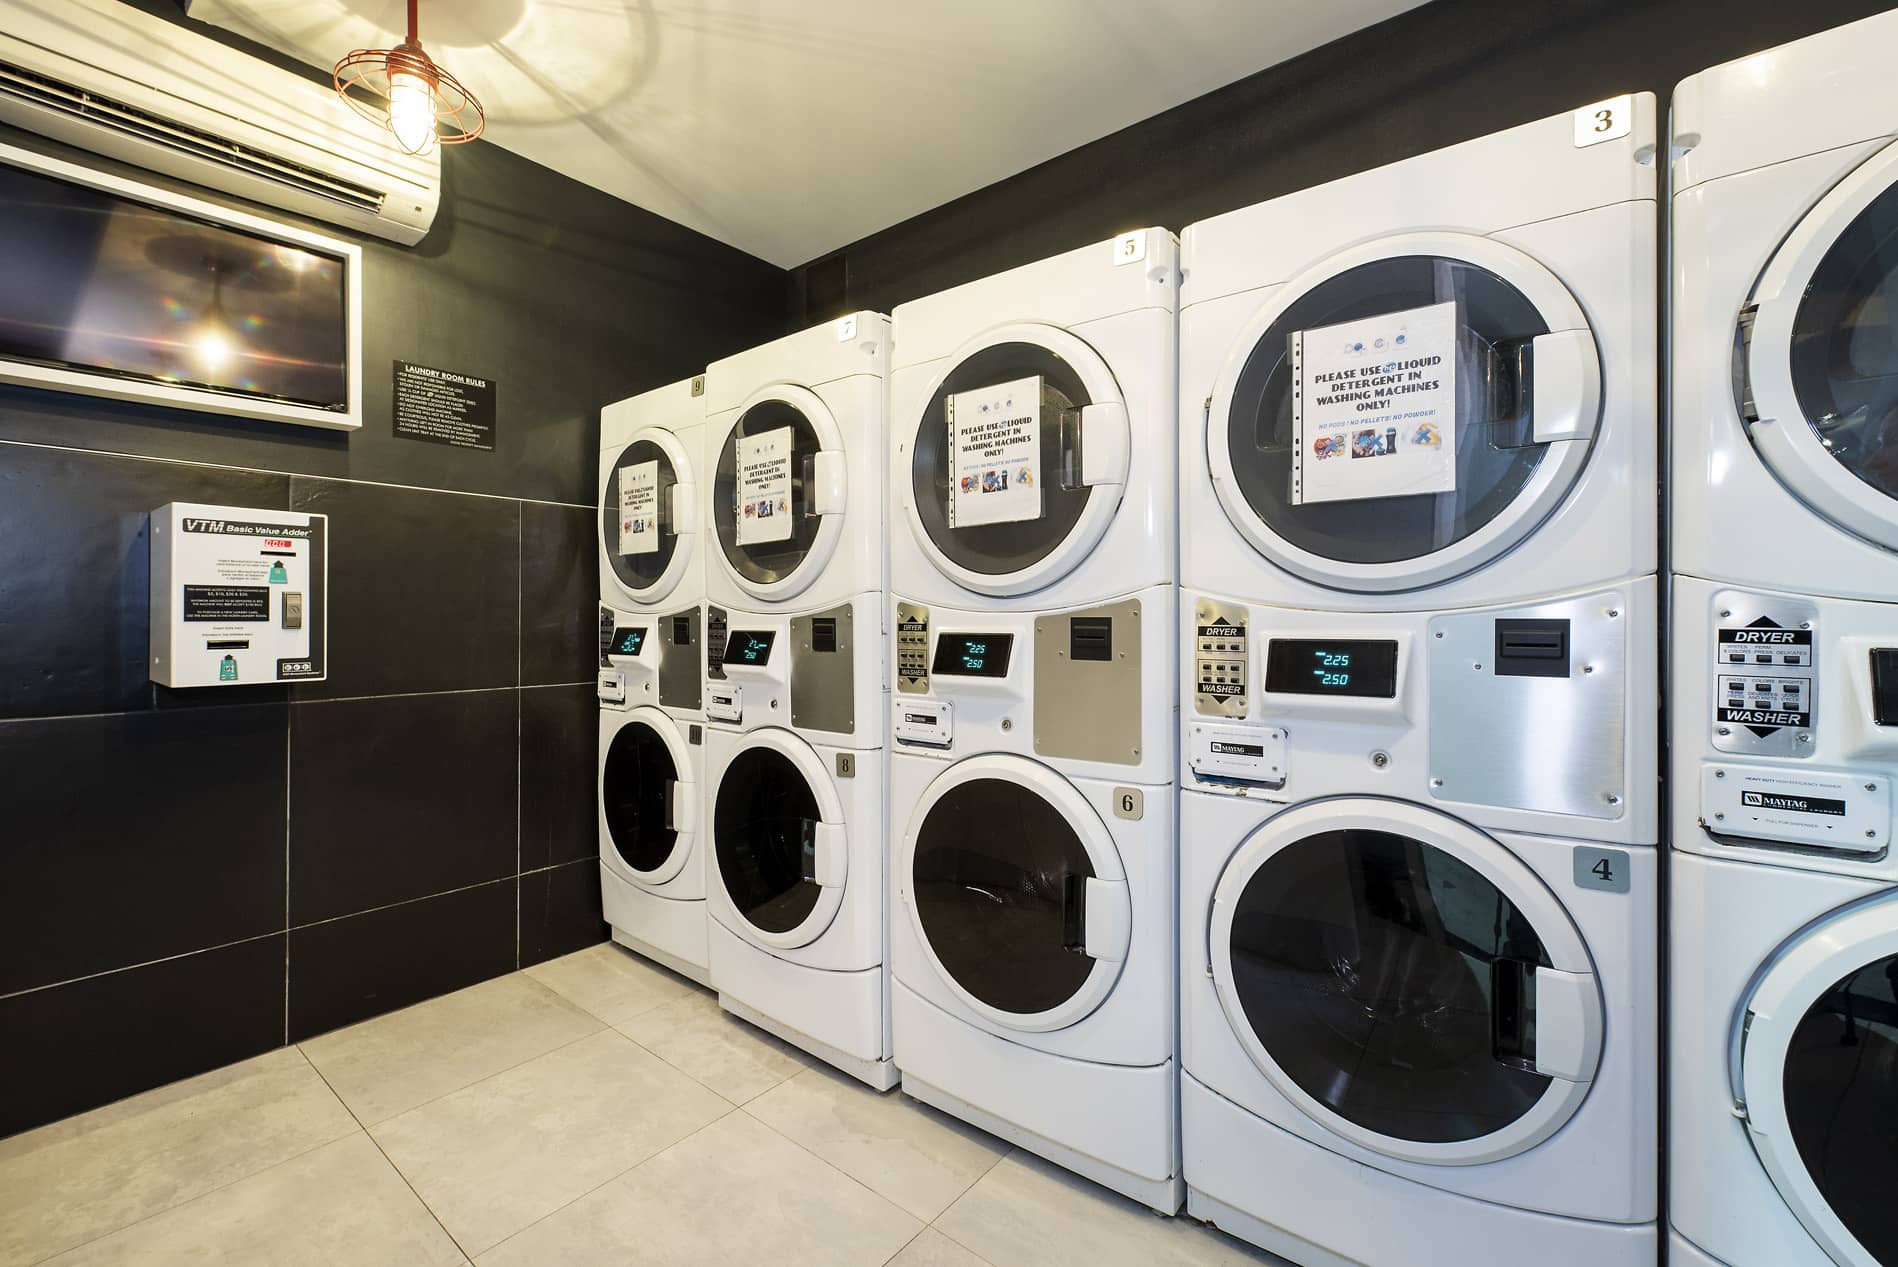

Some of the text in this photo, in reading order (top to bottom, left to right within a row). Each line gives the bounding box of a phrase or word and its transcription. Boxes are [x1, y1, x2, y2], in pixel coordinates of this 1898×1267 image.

[1594, 110, 1612, 132] 3
[1124, 239, 1136, 256] 5
[405, 364, 439, 378] LAUNDRY
[442, 372, 463, 383] ROOM
[465, 376, 485, 387] RULES
[1315, 369, 1356, 383] PLEASE
[1361, 366, 1382, 376] USE
[1332, 370, 1422, 392] DETERGENT IN
[1317, 380, 1440, 406] WASHING MACHINES
[1356, 399, 1391, 412] ONLY!
[1393, 413, 1402, 421] NO
[1404, 409, 1436, 419] POWDER!
[961, 425, 984, 435] PLEASE
[971, 430, 1011, 442] DETERGENT
[962, 435, 1031, 452] WASHING MACHINES
[984, 448, 1004, 457] ONLY!
[186, 519, 309, 537] VTM Basic Value Adder
[1206, 628, 1237, 636] DRYER
[1735, 631, 1795, 643] DRYER
[1202, 684, 1241, 694] WASHER
[1727, 710, 1801, 725] WASHER
[842, 759, 849, 772] 8
[1122, 794, 1133, 812] 6
[1763, 797, 1808, 808] MAYTAG
[1591, 859, 1613, 881] 4
